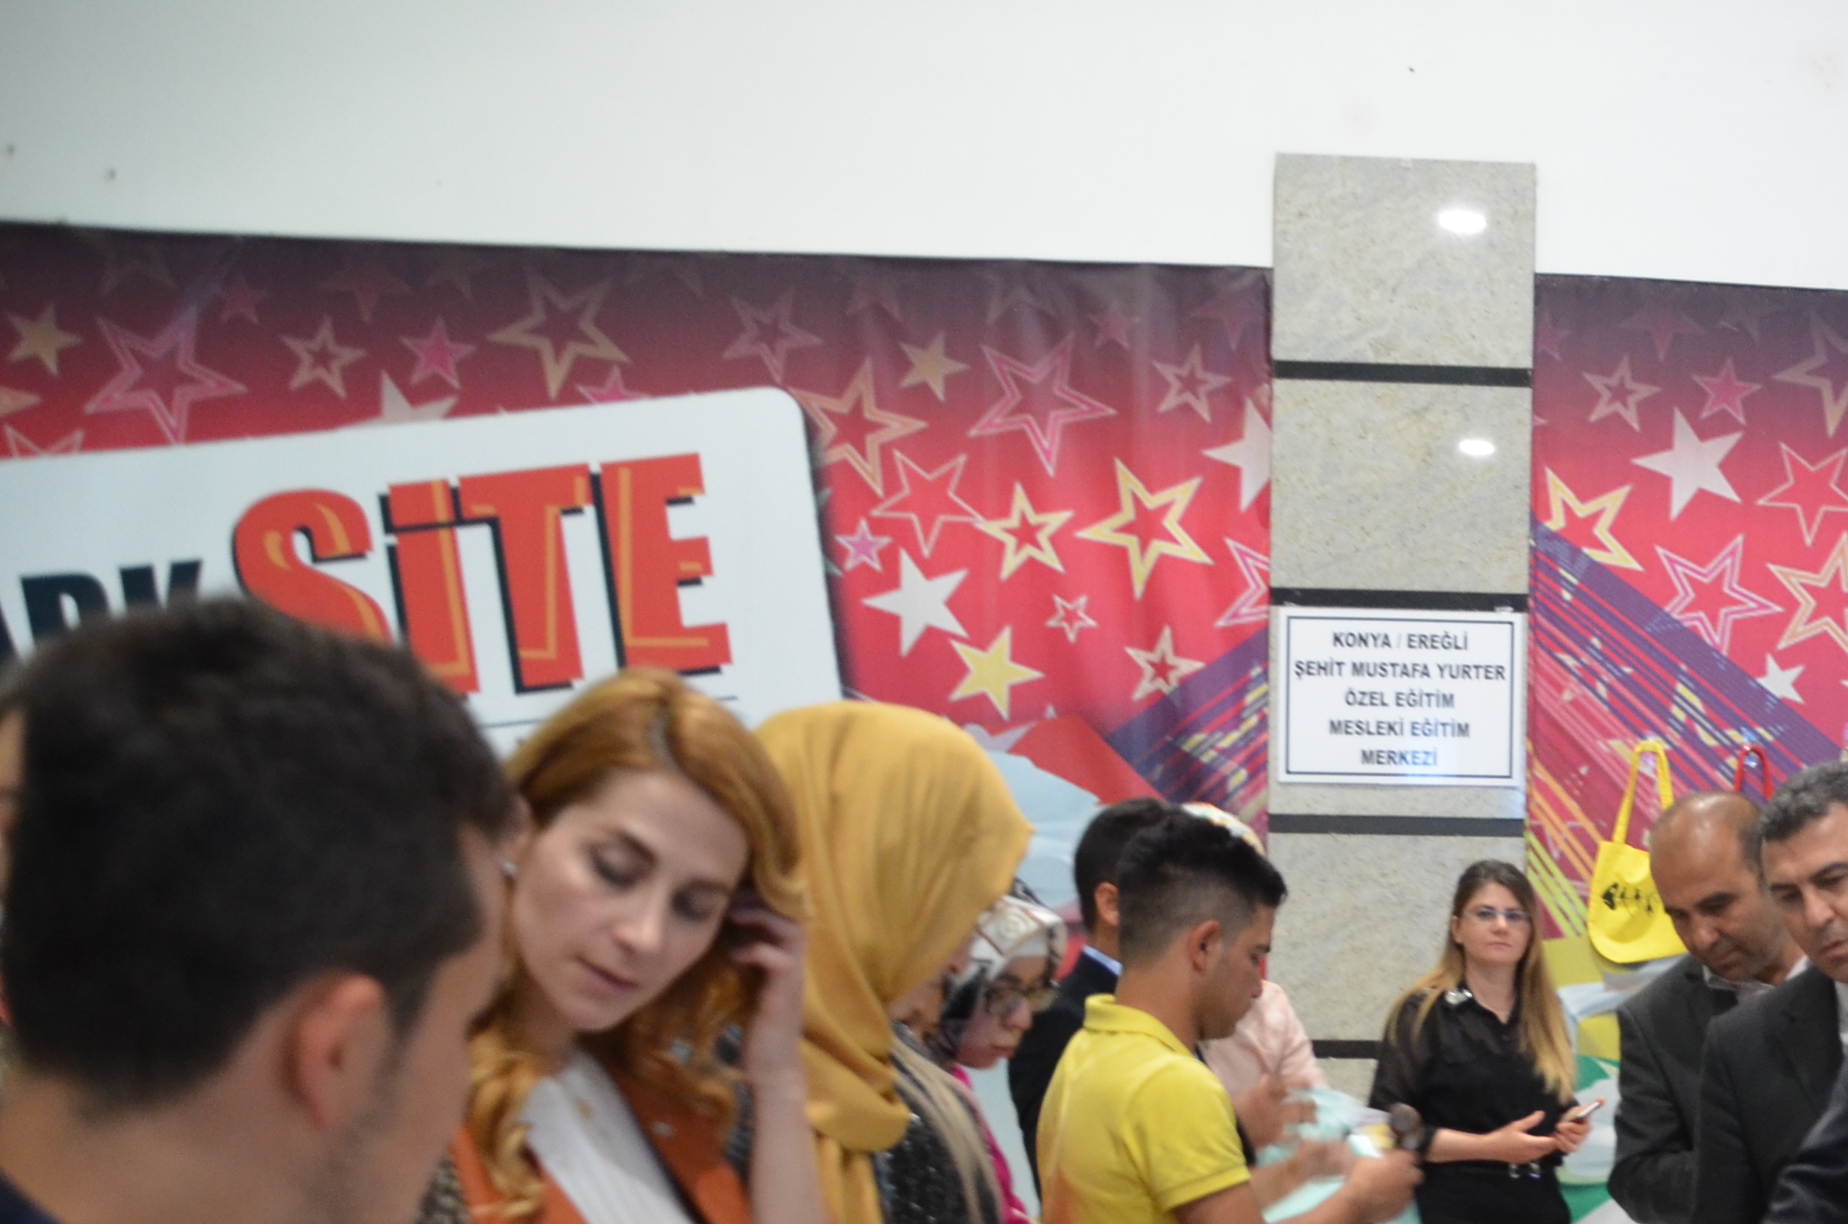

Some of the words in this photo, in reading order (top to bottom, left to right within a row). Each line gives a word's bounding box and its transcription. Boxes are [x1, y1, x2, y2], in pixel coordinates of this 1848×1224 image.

[1332, 631, 1392, 649] KONYA
[1407, 629, 1468, 651] EREĞLİ
[1294, 656, 1345, 680] ŞEHİT
[1351, 661, 1431, 679] MUSTAFA
[1437, 663, 1506, 681] YURTER
[1345, 688, 1389, 707] ÖZEL
[1395, 687, 1455, 709] EĞİTİM
[1329, 717, 1404, 737] MESLEKİ
[1410, 717, 1471, 739] EĞİTİM
[1360, 746, 1438, 767] MERKEZİ
